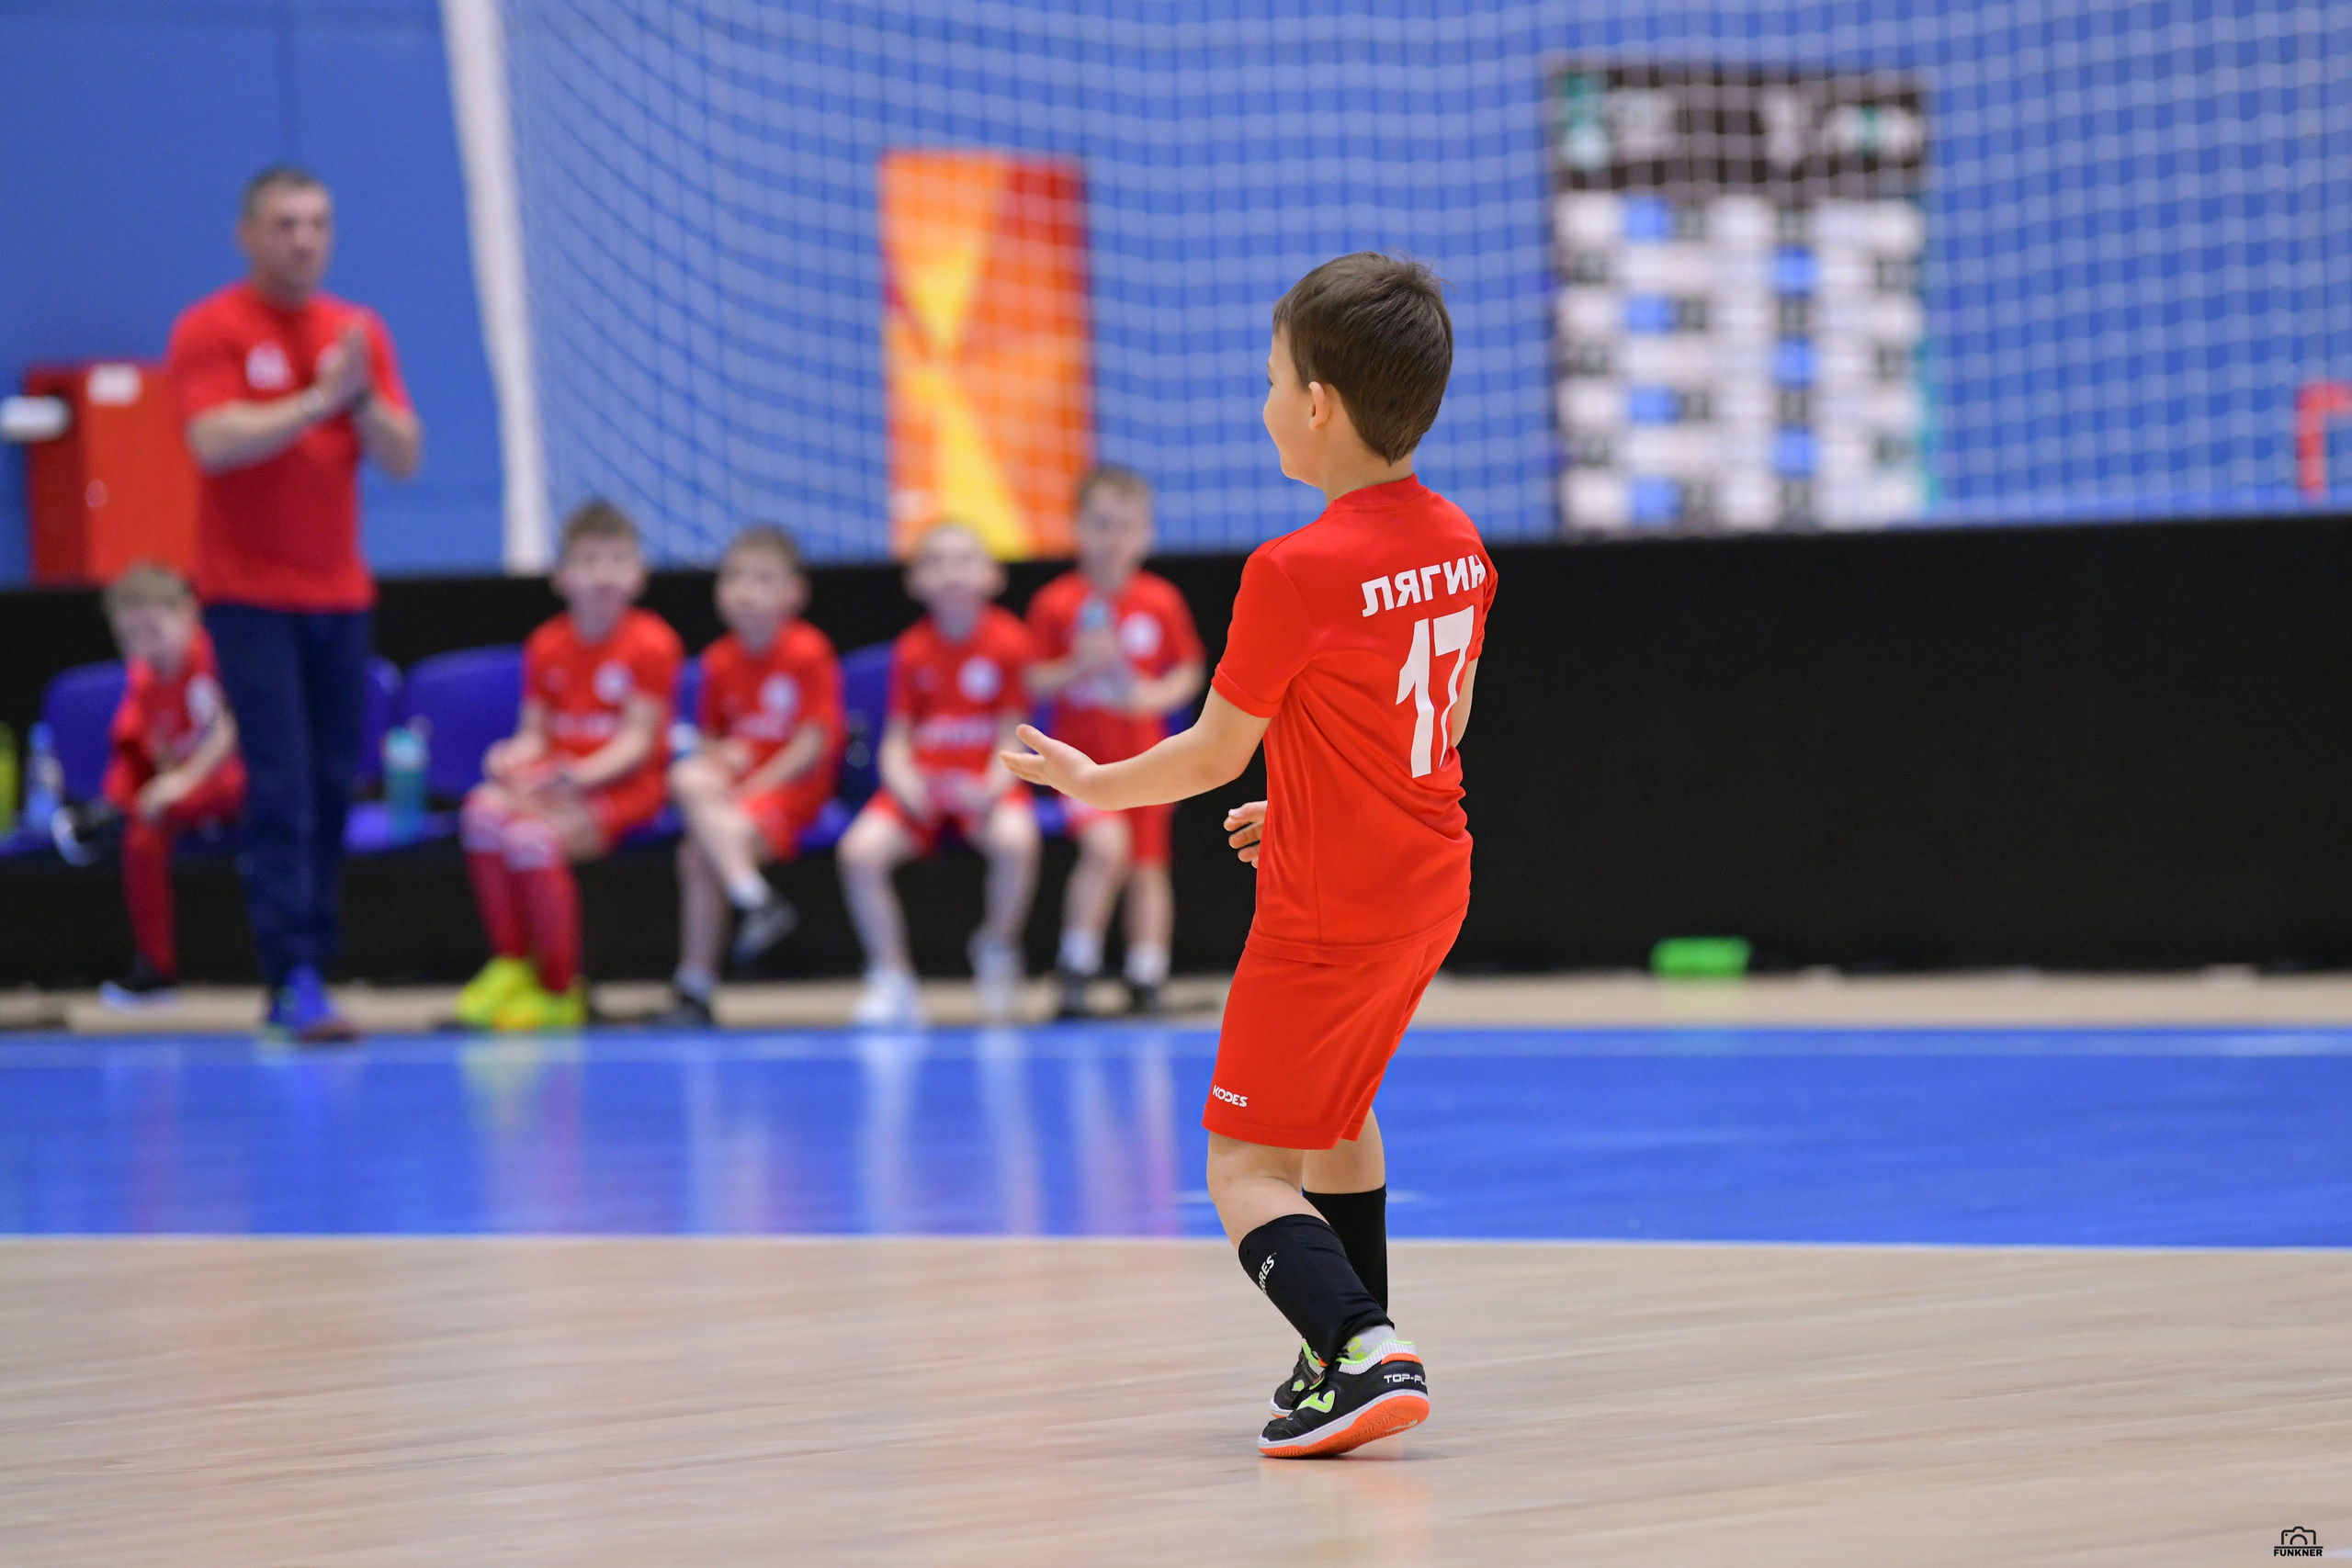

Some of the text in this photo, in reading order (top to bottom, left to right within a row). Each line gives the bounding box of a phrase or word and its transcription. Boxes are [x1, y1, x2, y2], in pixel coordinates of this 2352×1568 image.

[1361, 554, 1487, 617] ЛЯГИН
[1396, 604, 1475, 779] 17
[1213, 1084, 1249, 1108] KODES
[1384, 1372, 1426, 1386] TOP-FL
